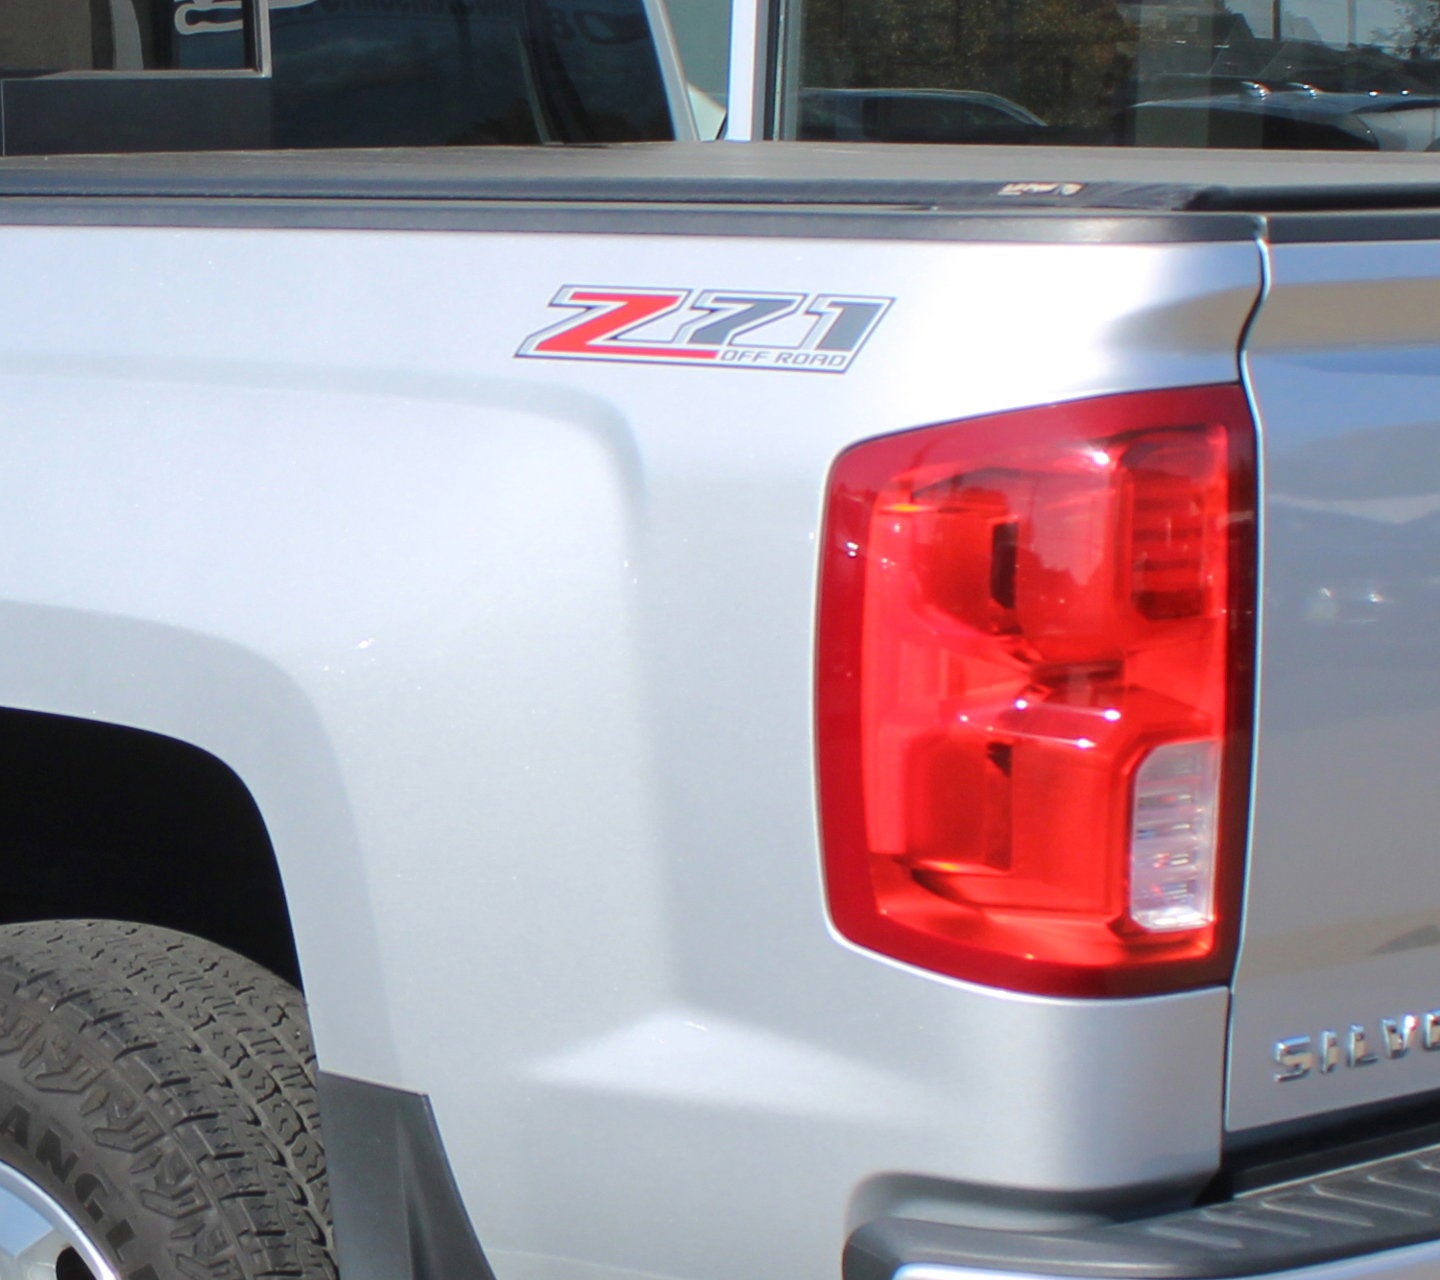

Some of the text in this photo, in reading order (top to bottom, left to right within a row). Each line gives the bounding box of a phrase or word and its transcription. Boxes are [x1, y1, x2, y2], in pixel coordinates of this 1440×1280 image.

[514, 284, 897, 374] Z71
[720, 350, 848, 367] OFF ROAD
